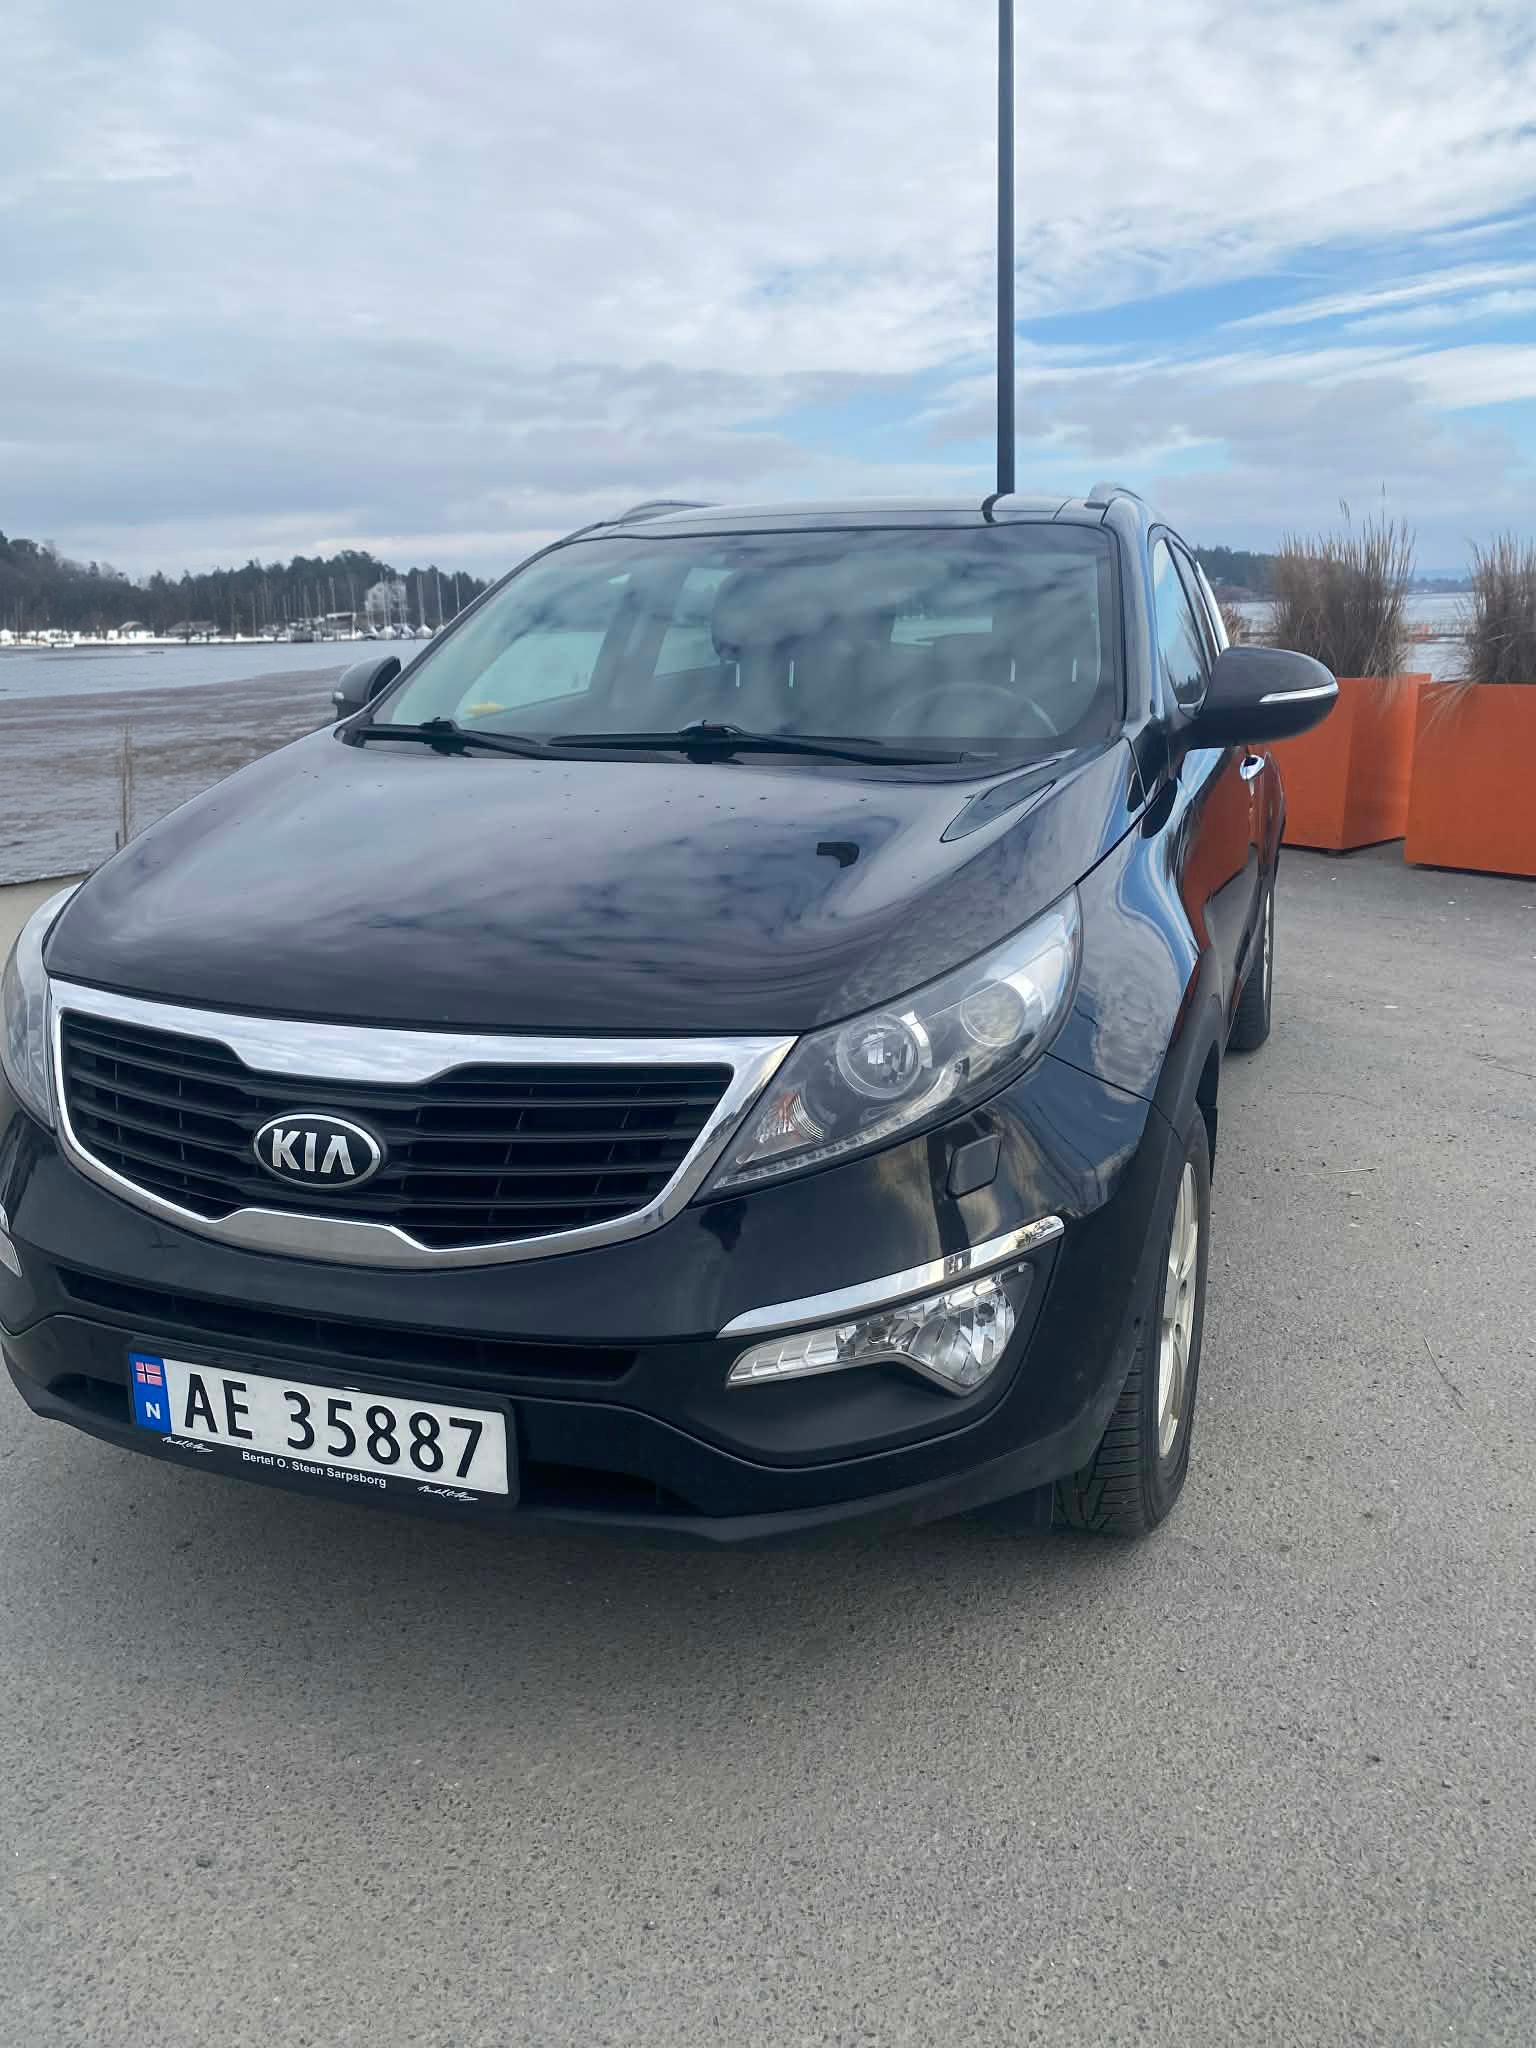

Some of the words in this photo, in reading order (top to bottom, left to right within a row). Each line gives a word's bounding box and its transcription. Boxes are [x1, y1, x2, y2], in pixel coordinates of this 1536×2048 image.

[272, 1128, 356, 1176] KIA
[146, 1402, 161, 1420] N
[184, 1373, 254, 1441] AE
[283, 1390, 484, 1479] 35887
[242, 1451, 274, 1466] Bertel
[276, 1458, 290, 1469] O.
[292, 1461, 324, 1476] Steen
[326, 1467, 387, 1489] Sarpsborg
